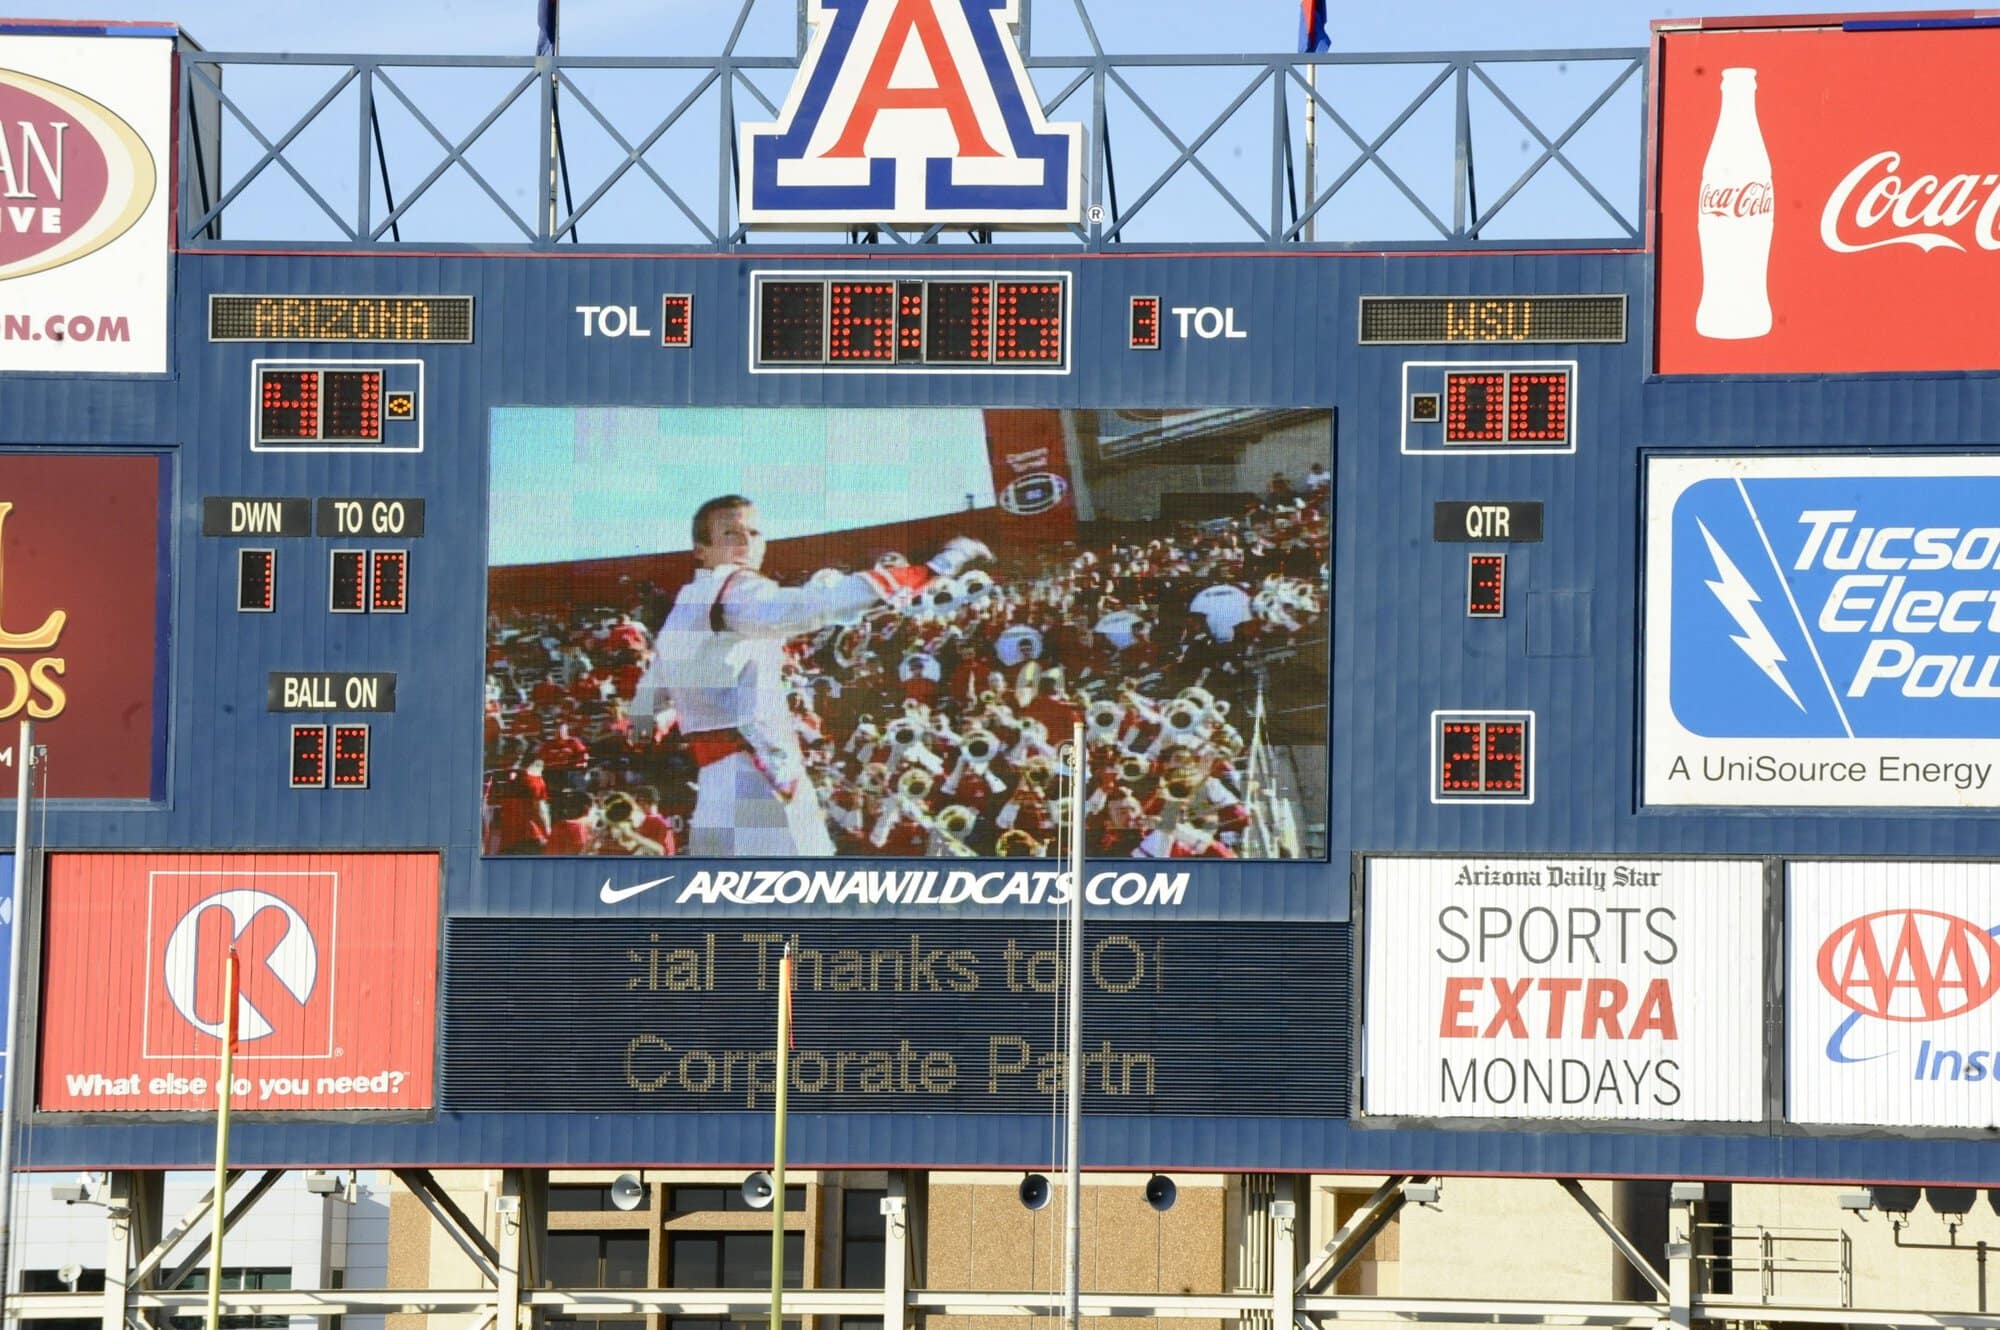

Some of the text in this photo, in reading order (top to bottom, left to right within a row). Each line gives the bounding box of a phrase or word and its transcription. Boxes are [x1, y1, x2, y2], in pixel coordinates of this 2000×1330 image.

[255, 298, 429, 339] ARIZONA
[576, 306, 650, 337] TOL
[665, 299, 689, 342] 3
[1132, 300, 1156, 343] 3
[1172, 307, 1247, 338] TOL
[1446, 302, 1530, 340] WSU
[264, 373, 379, 436] 41
[1449, 375, 1566, 440] 00
[231, 502, 281, 533] DWN
[334, 502, 405, 534] TO GO
[1466, 505, 1510, 538] QTR
[356, 554, 403, 607] 10
[1472, 557, 1502, 611] 3
[284, 677, 377, 709] BALL ON
[294, 729, 366, 782] 35
[1444, 725, 1522, 789] 25
[1668, 756, 1993, 790] A UniSource Energy
[1455, 865, 1662, 892] Arizona Daily Star
[1436, 906, 1678, 965] SPORTS
[743, 932, 980, 993] Thanks
[1003, 938, 1066, 993] to
[1439, 977, 1679, 1040] EXTRA
[66, 1073, 140, 1097] What
[149, 1072, 207, 1095] else
[259, 1077, 309, 1100] you
[316, 1071, 404, 1094] need?
[624, 1033, 957, 1110] Corporate
[1441, 1058, 1681, 1106] MONDAYS
